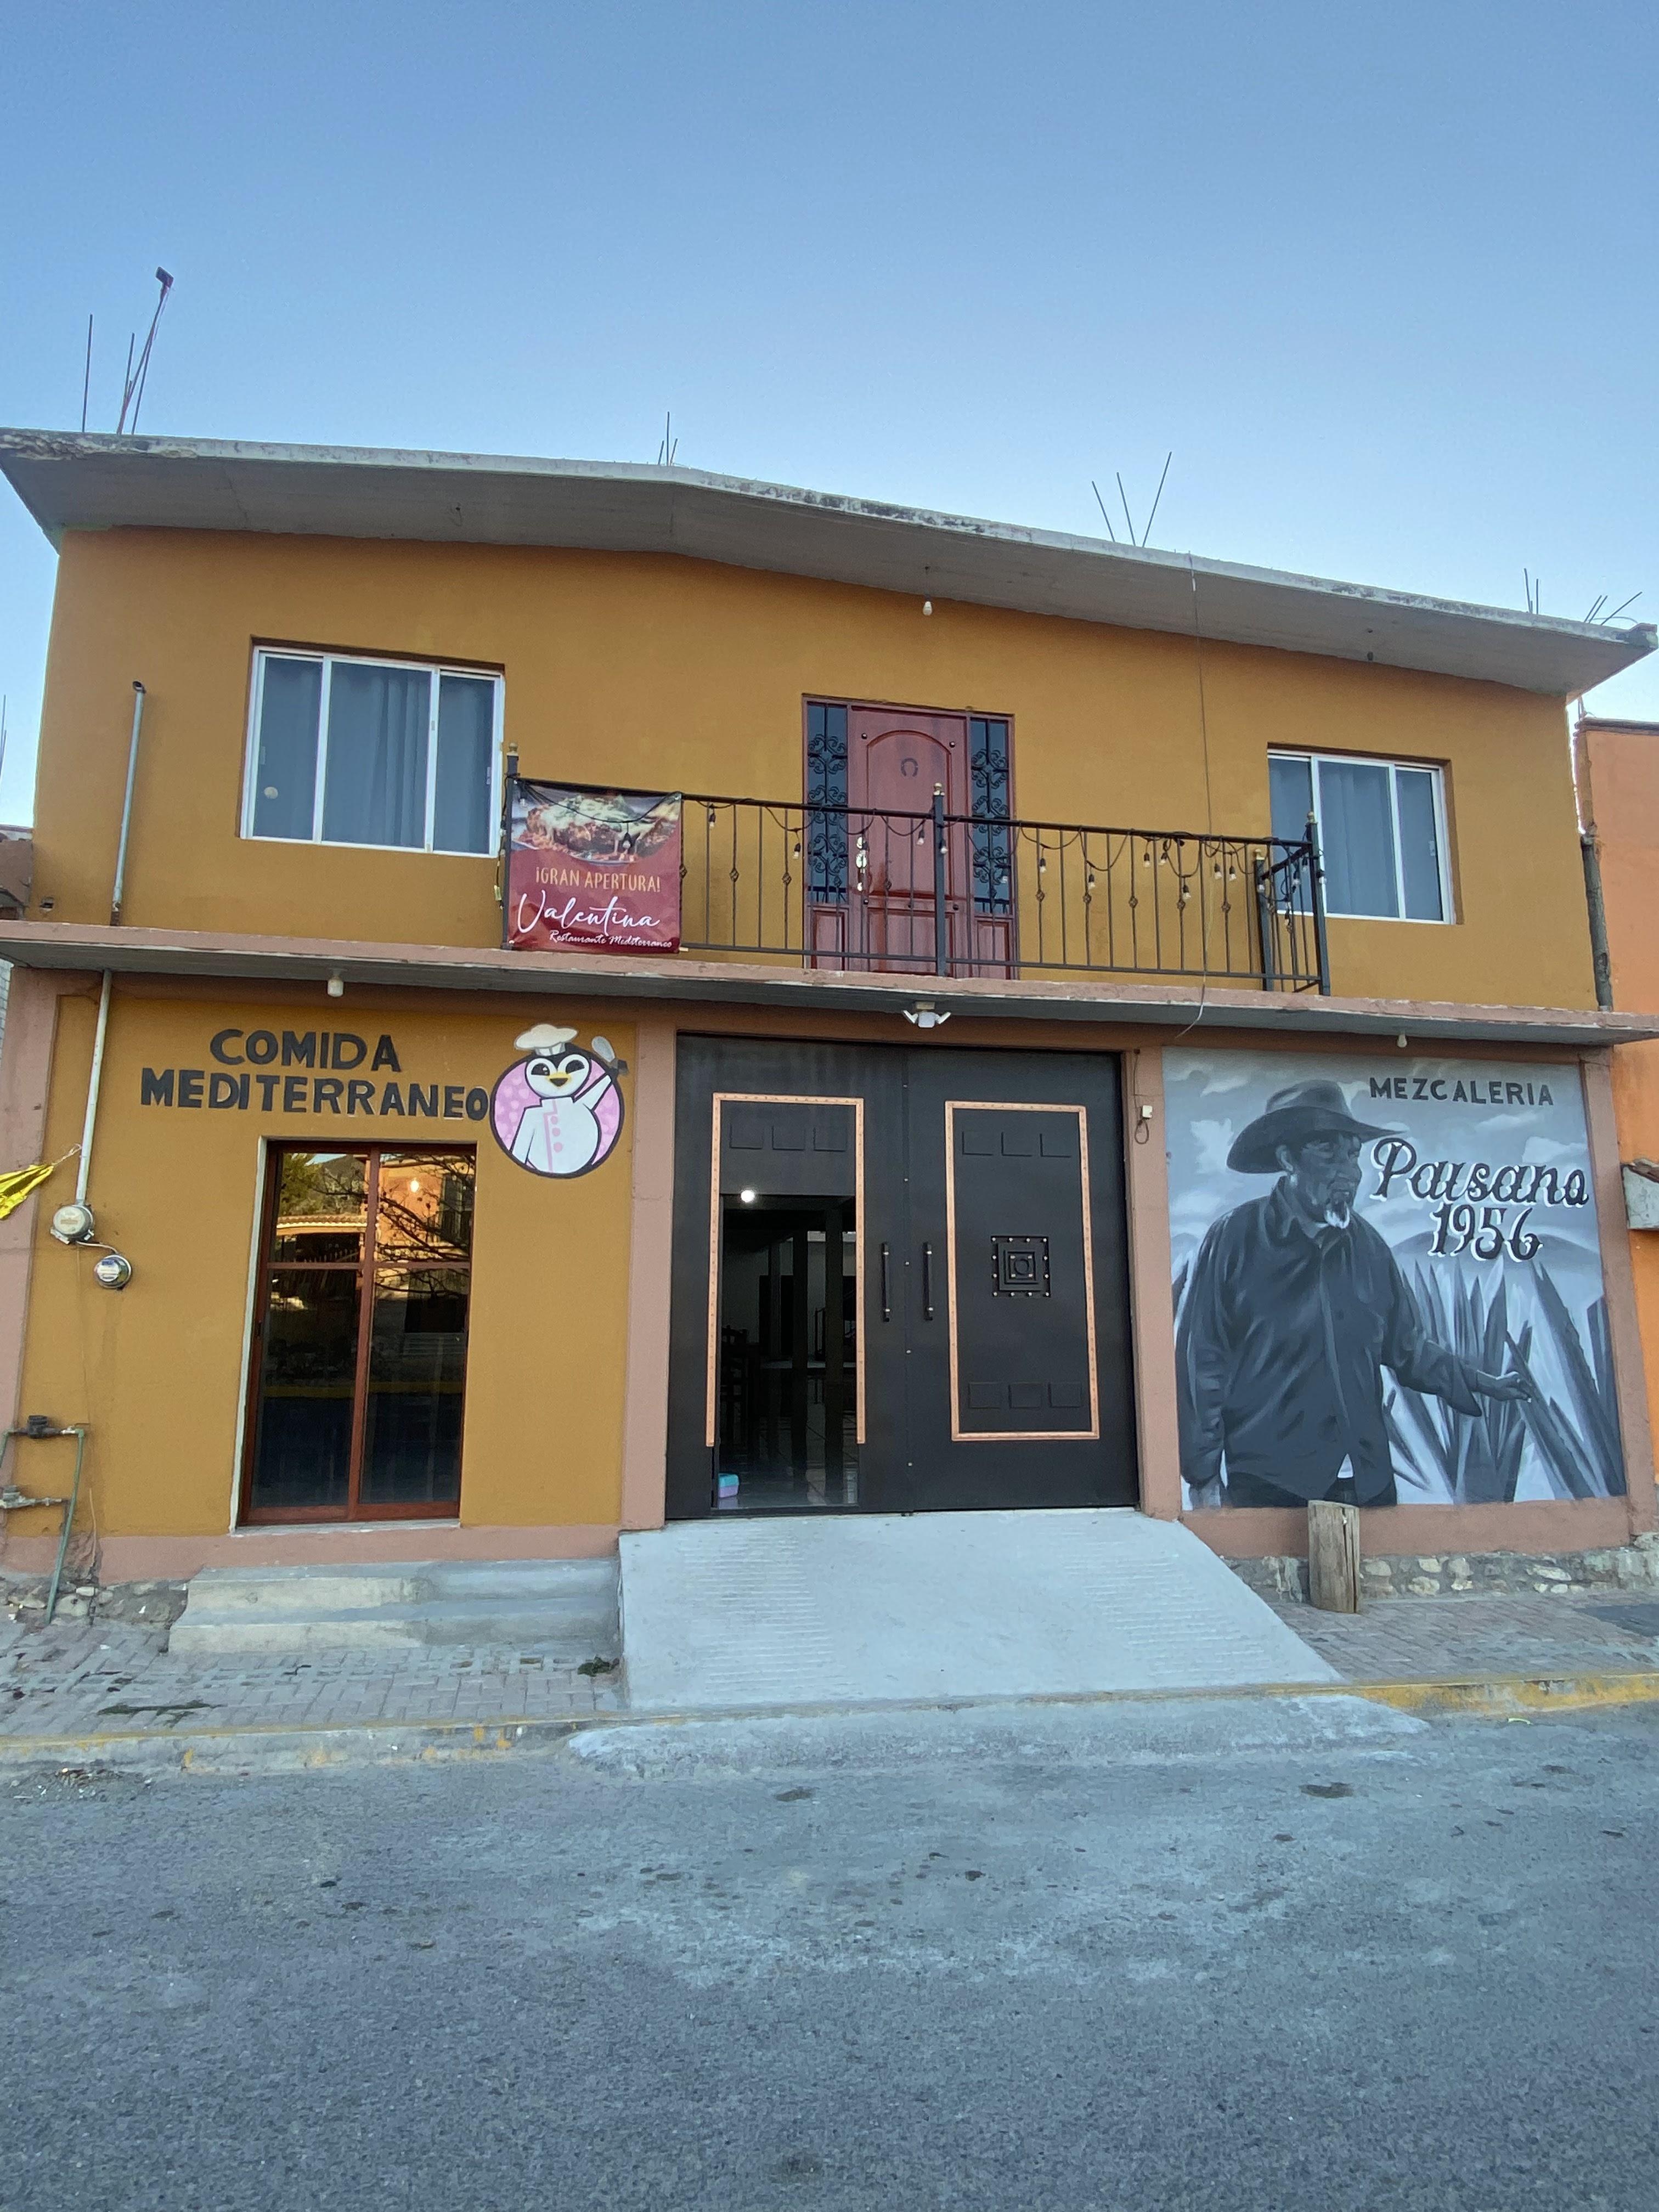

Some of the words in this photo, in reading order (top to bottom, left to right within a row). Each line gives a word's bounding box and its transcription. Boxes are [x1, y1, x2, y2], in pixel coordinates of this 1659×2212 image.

[585, 872, 661, 893] APERTURA!
[517, 890, 660, 936] Valentina
[210, 1029, 402, 1073] COMIDA
[140, 1068, 490, 1121] MEDITERRANEO
[1369, 1077, 1554, 1106] MEZCALERIA
[1428, 1203, 1543, 1262] 1956
